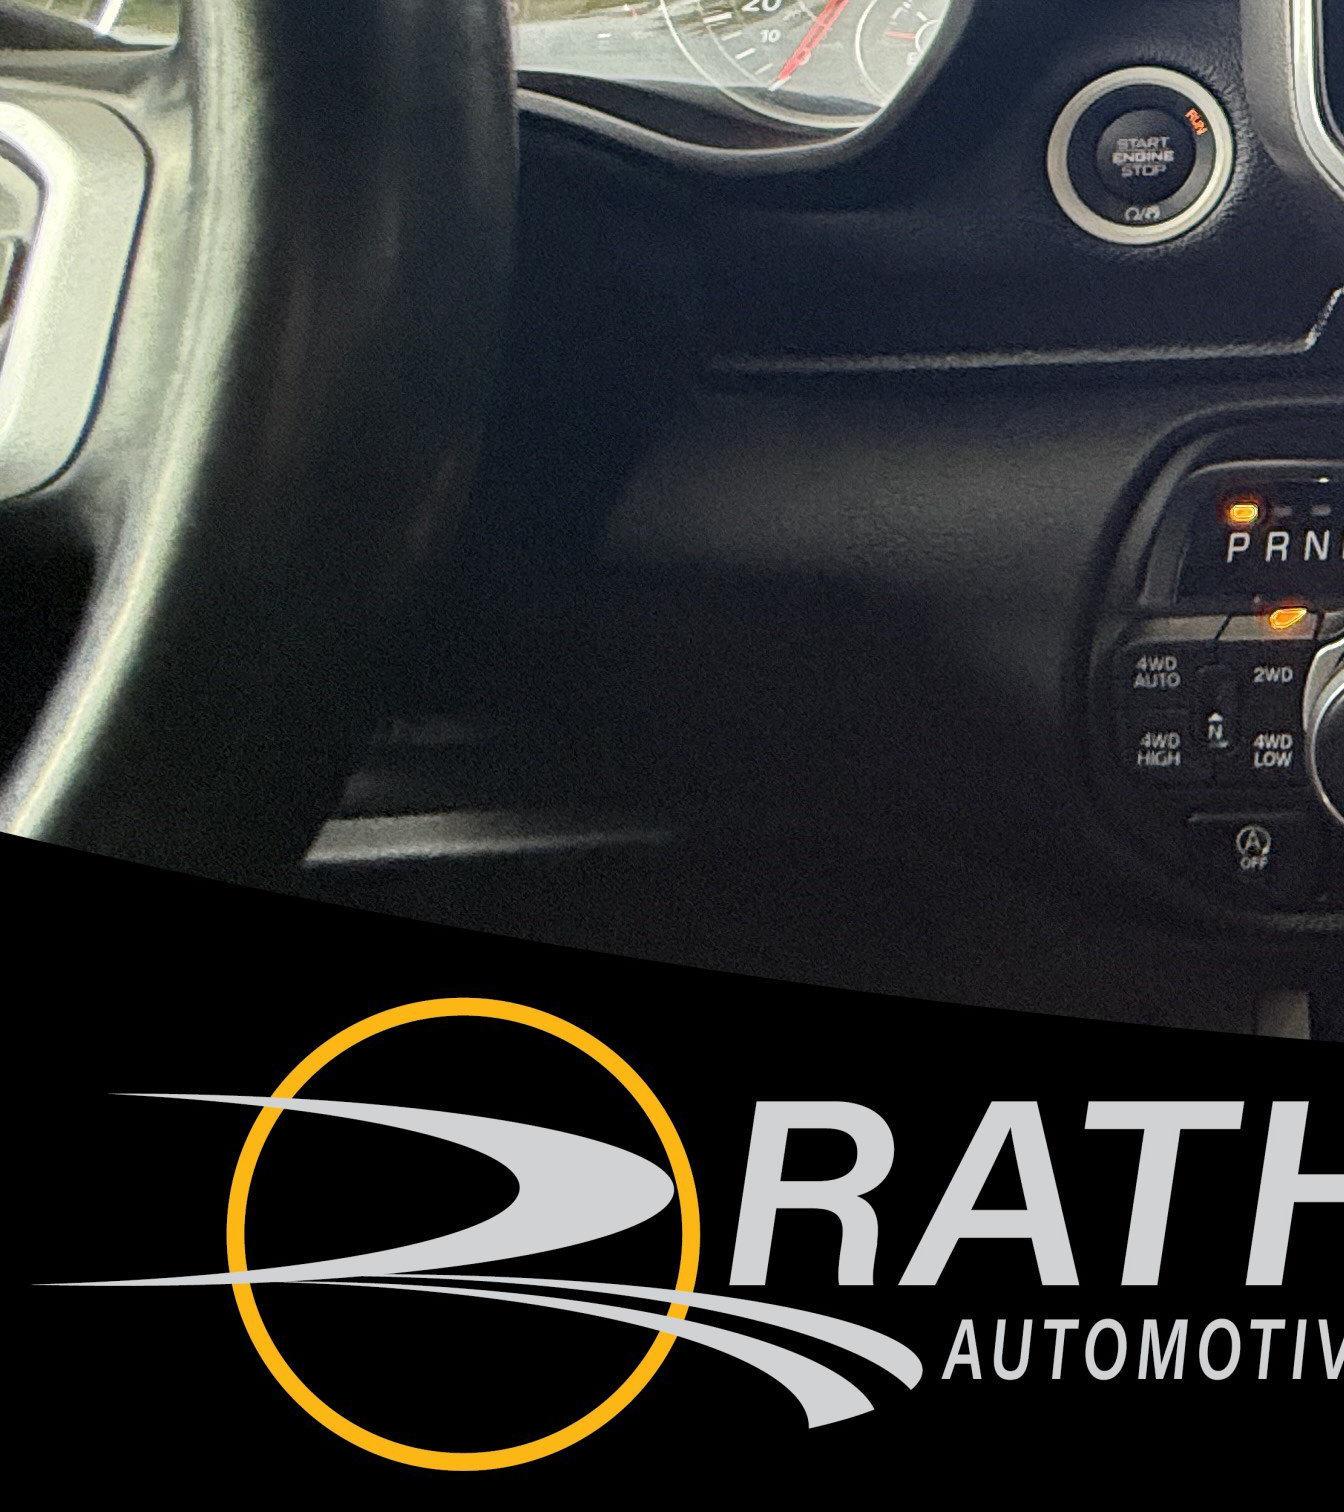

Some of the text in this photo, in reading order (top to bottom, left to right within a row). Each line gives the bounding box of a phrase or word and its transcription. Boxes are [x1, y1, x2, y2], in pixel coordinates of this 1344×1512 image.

[760, 29, 780, 42] 10
[1117, 136, 1170, 151] START
[1112, 150, 1174, 164] ENGINE
[1121, 164, 1167, 177] STOP
[1136, 655, 1177, 671] 4WD
[1133, 671, 1181, 688] AUTO
[1253, 666, 1293, 683] 2WD
[1140, 731, 1181, 749] 4WD
[1253, 733, 1293, 750] 4WD
[1137, 750, 1182, 767] HIGH
[1253, 750, 1293, 768] LOW
[1240, 855, 1268, 871] OFF
